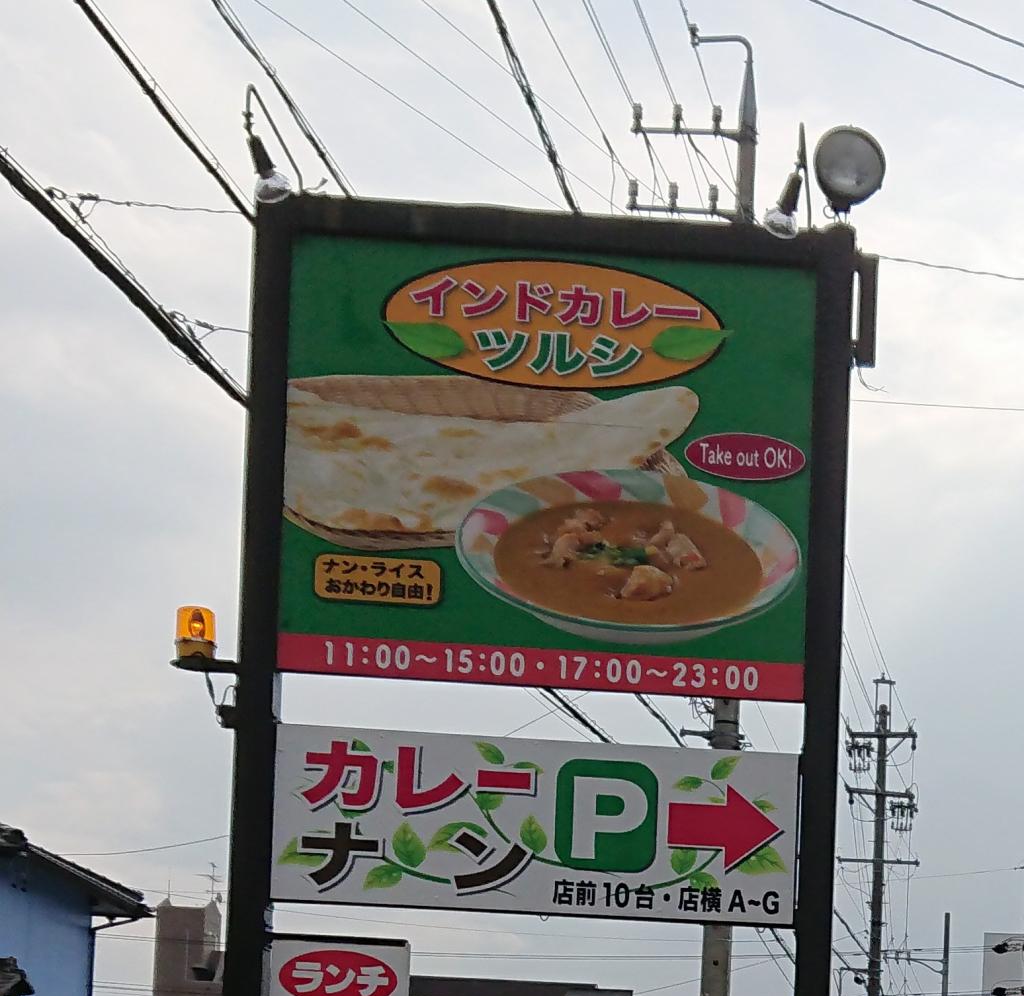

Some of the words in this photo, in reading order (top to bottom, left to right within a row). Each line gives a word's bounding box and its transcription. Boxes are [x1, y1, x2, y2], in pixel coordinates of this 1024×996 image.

[410, 274, 703, 328] インドカレー
[473, 327, 643, 379] ツルシ
[700, 443, 732, 465] Take
[736, 450, 759, 467] out
[764, 447, 792, 469] OK!
[322, 559, 424, 579] ナン・ライス
[300, 739, 538, 816] カレー
[300, 822, 535, 895] ナン
[291, 961, 389, 996] ランチ
